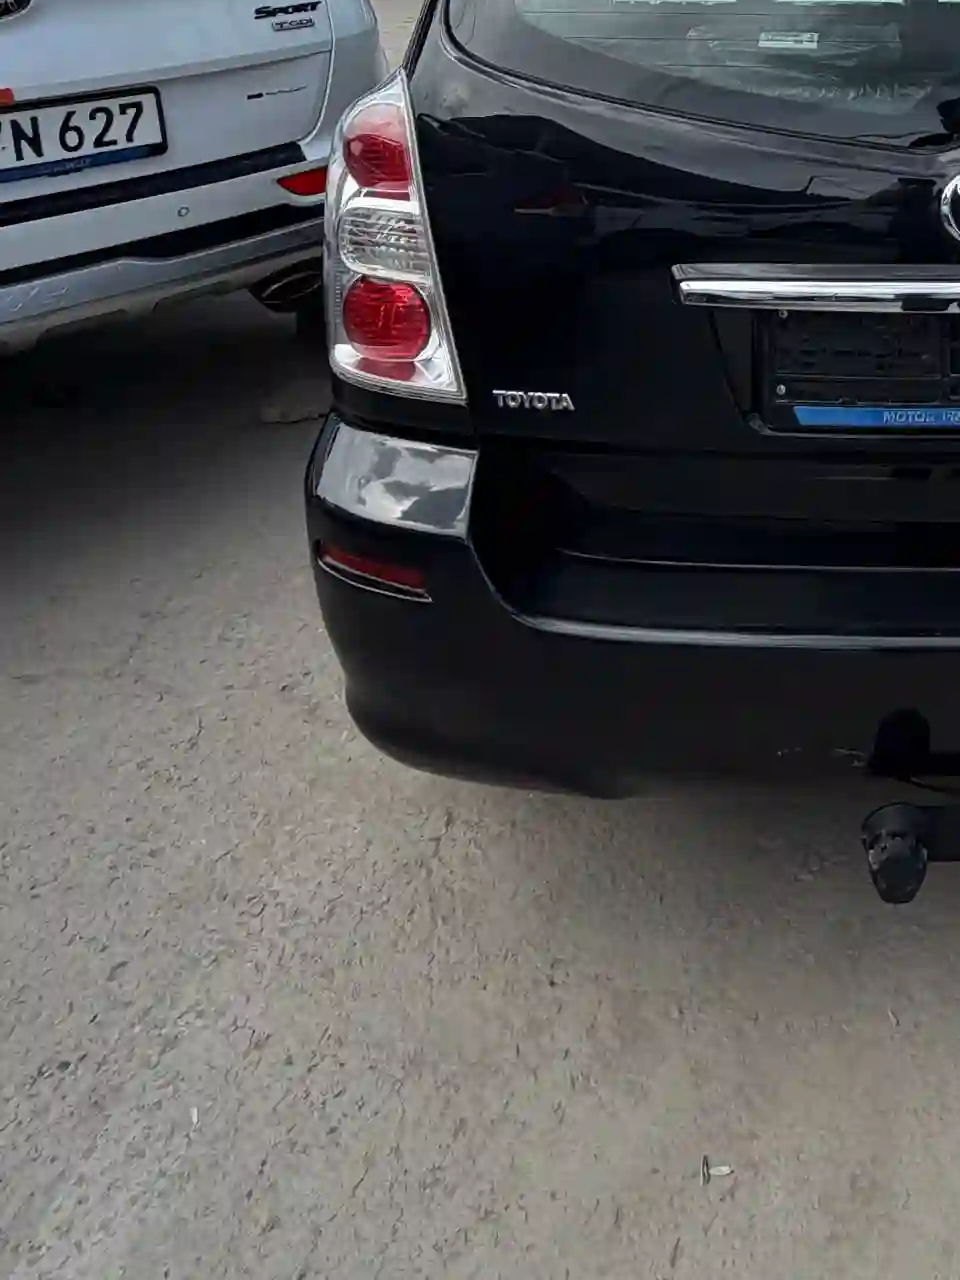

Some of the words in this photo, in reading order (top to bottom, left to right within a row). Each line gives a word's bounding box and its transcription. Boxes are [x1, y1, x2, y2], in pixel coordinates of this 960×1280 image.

[0, 116, 44, 161] N
[59, 101, 144, 152] 627
[492, 389, 576, 411] TOYOTA
